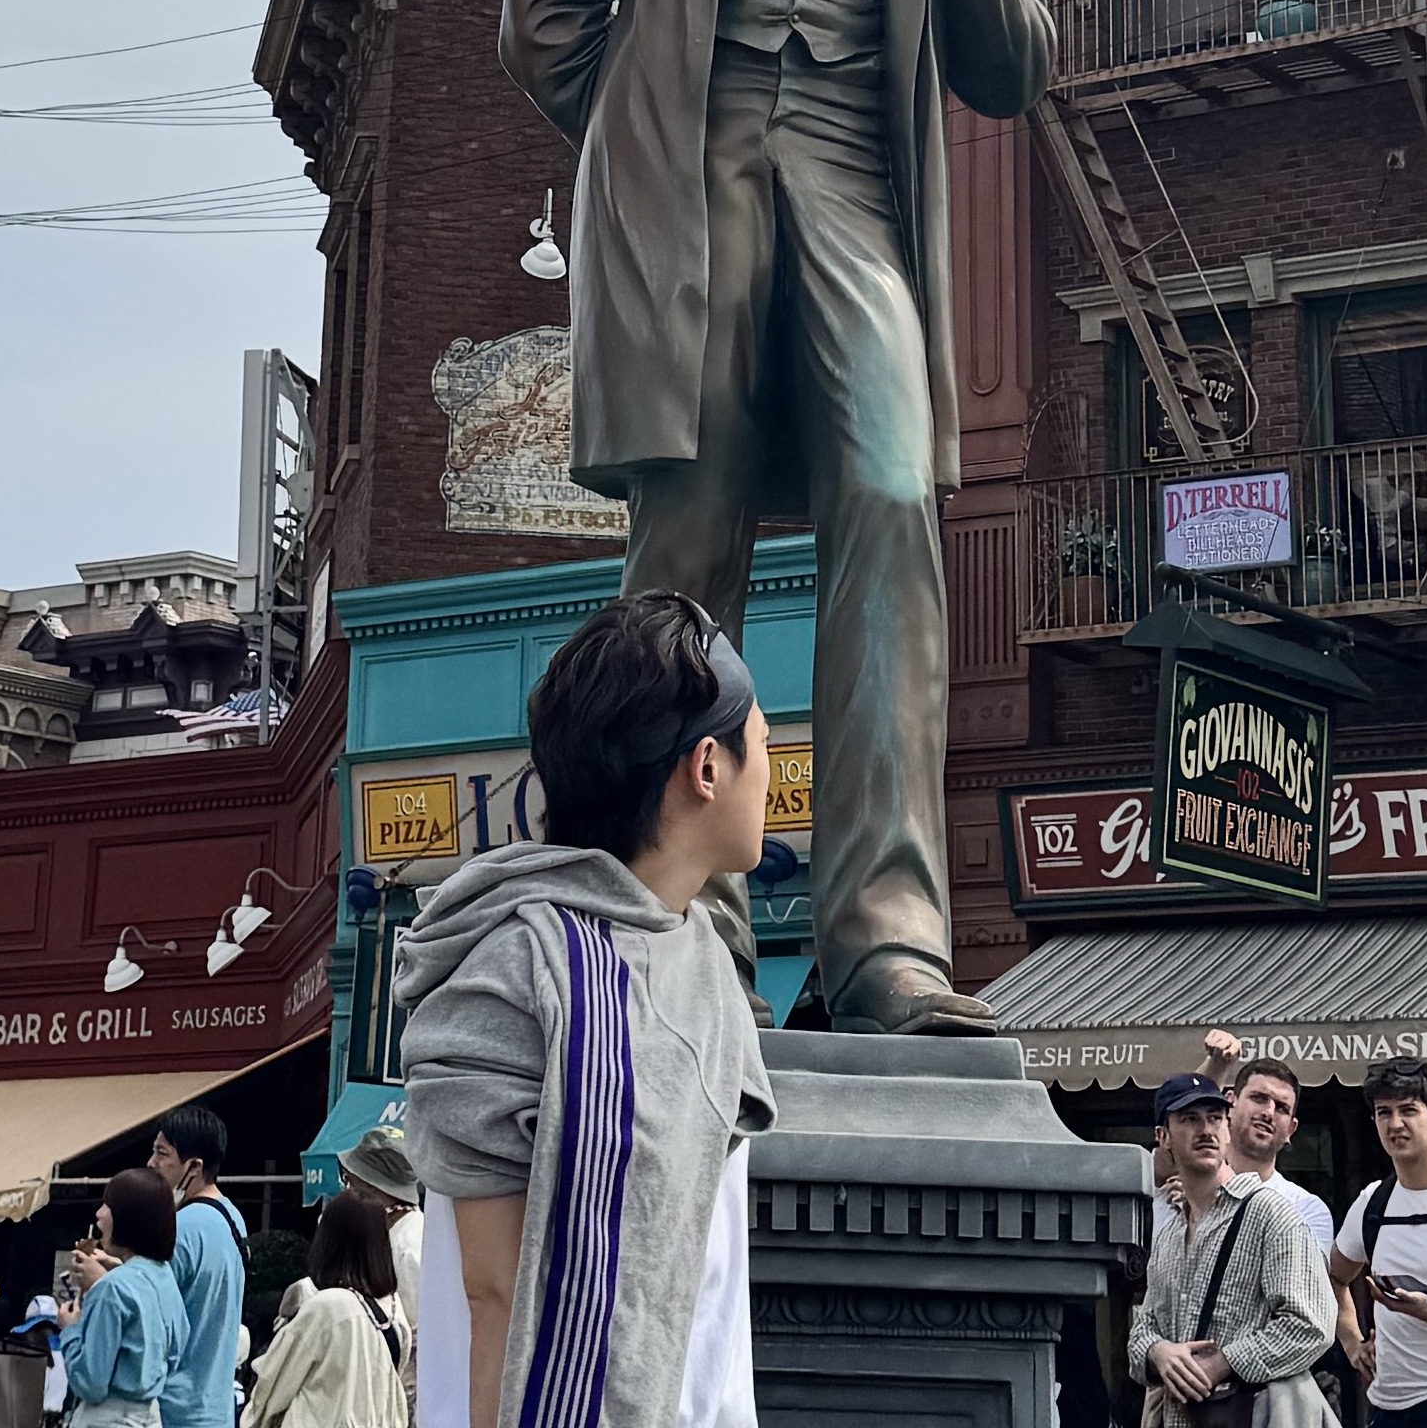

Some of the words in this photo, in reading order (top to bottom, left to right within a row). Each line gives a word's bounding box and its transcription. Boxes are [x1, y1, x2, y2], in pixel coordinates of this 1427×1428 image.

[1177, 518, 1276, 539] LETTERHEADS
[1188, 532, 1264, 552] BILLHEADS
[1185, 547, 1267, 567] STATIONERY
[1180, 702, 1314, 815] GIOVANNASI'S
[1236, 768, 1260, 801] 102
[394, 792, 428, 817] 104
[380, 816, 445, 845] PIZZA
[1035, 822, 1079, 856] 102
[1174, 788, 1222, 845] FRUIT
[1225, 802, 1313, 876] EXCHANGE
[48, 1011, 69, 1045] &
[76, 1007, 154, 1043] GRILL
[171, 1004, 268, 1030] SAUSAGES
[1025, 1046, 1072, 1067] ESH
[1080, 1044, 1149, 1067] FRUIT
